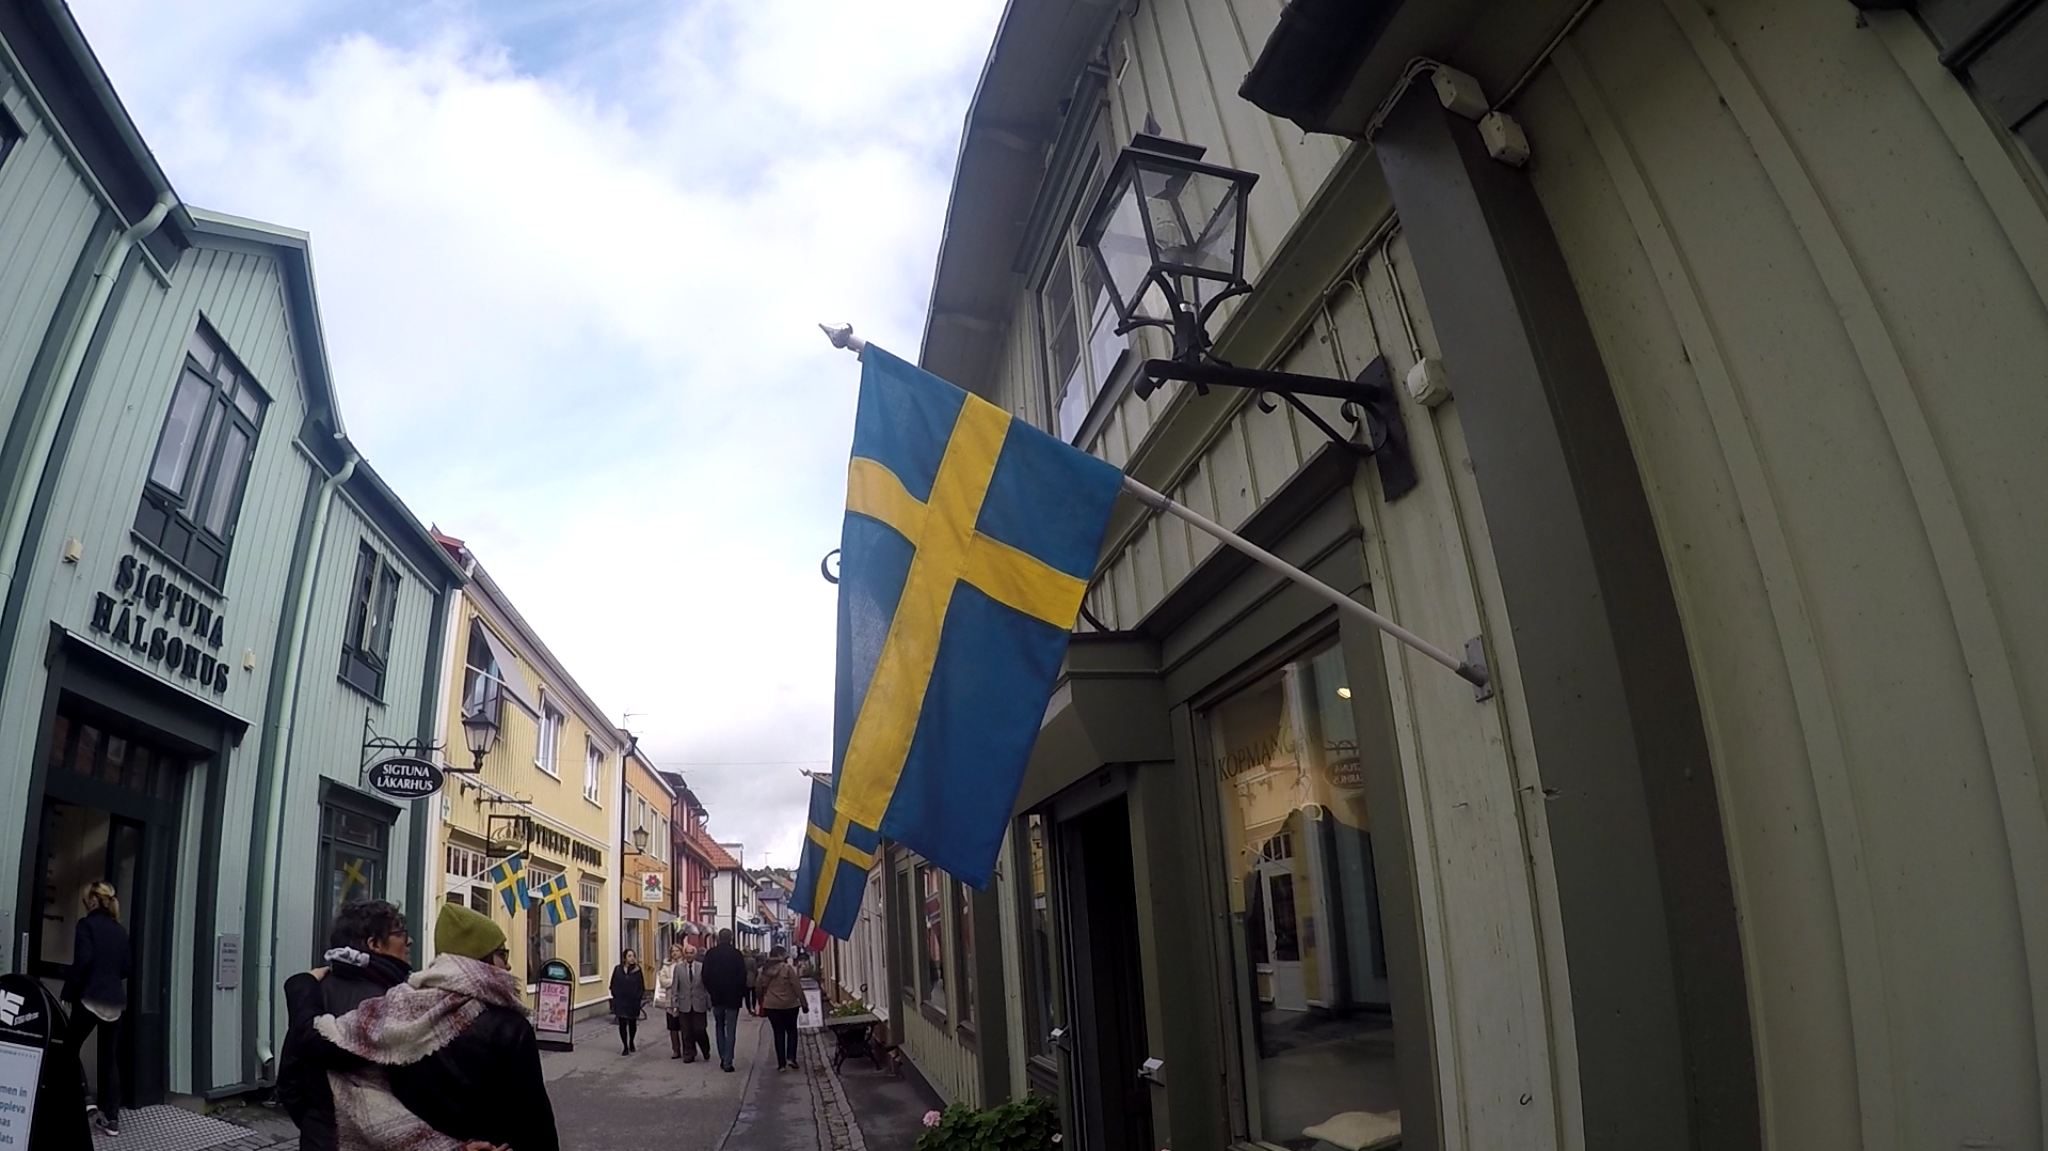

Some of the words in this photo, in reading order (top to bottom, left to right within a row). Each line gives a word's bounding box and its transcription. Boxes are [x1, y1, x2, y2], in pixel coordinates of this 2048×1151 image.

[115, 554, 226, 650] SIGTUNA
[90, 591, 230, 694] HÄLSOHUS
[382, 763, 430, 777] SIGTUNA
[377, 776, 434, 791] LÄKARHUS
[19, 1087, 28, 1098] in
